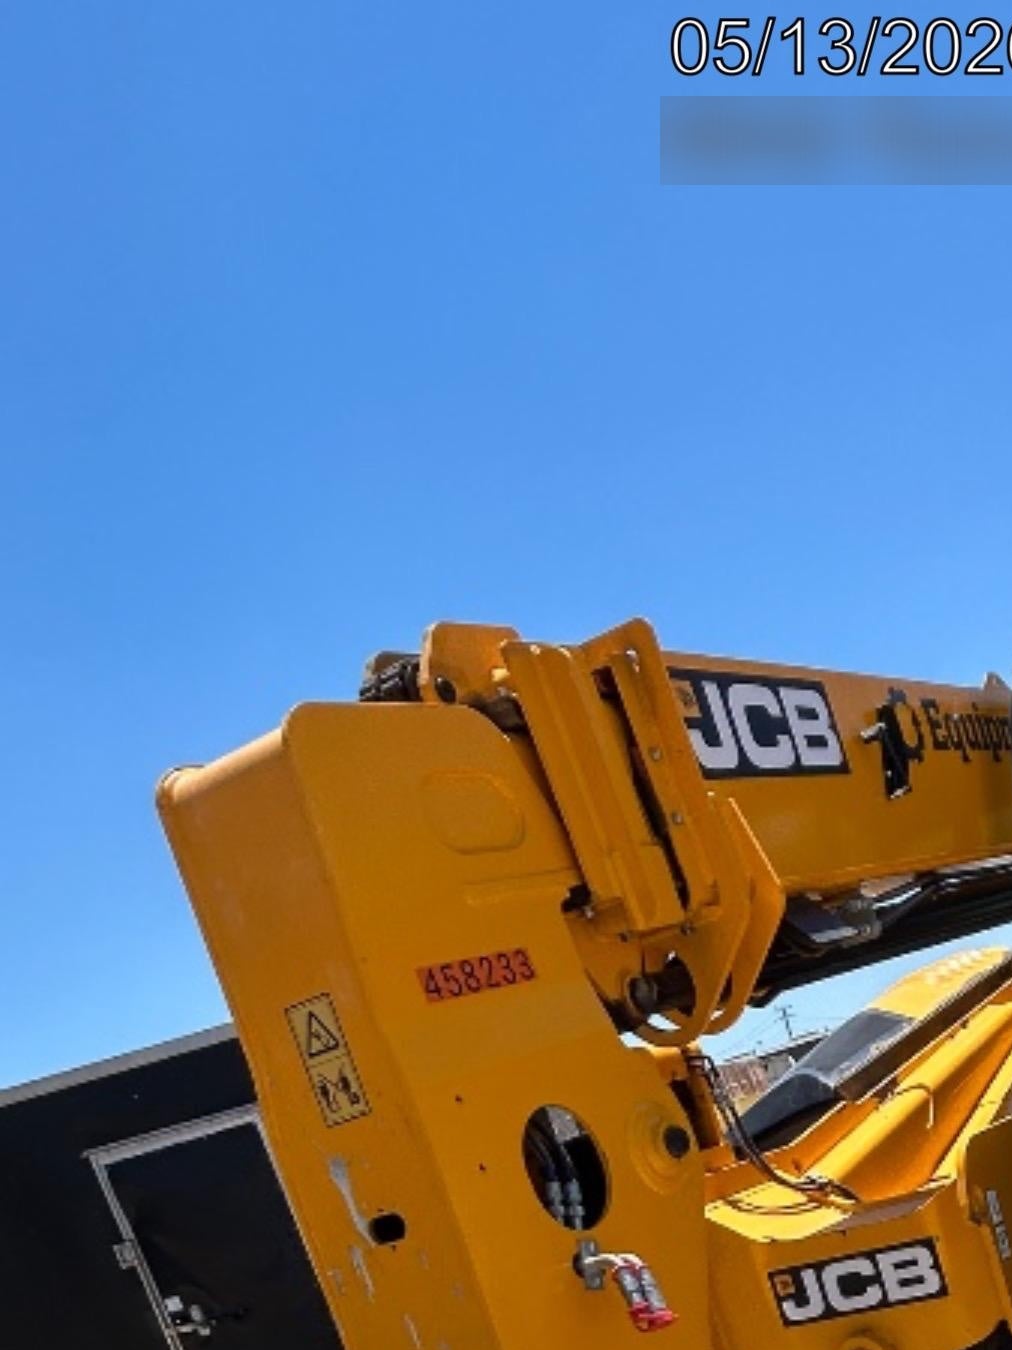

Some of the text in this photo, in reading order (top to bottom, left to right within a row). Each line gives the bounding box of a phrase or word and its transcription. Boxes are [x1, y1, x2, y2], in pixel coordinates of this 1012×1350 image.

[687, 679, 843, 769] JCB
[423, 948, 536, 1000] 458233
[780, 1245, 943, 1324] JCB
